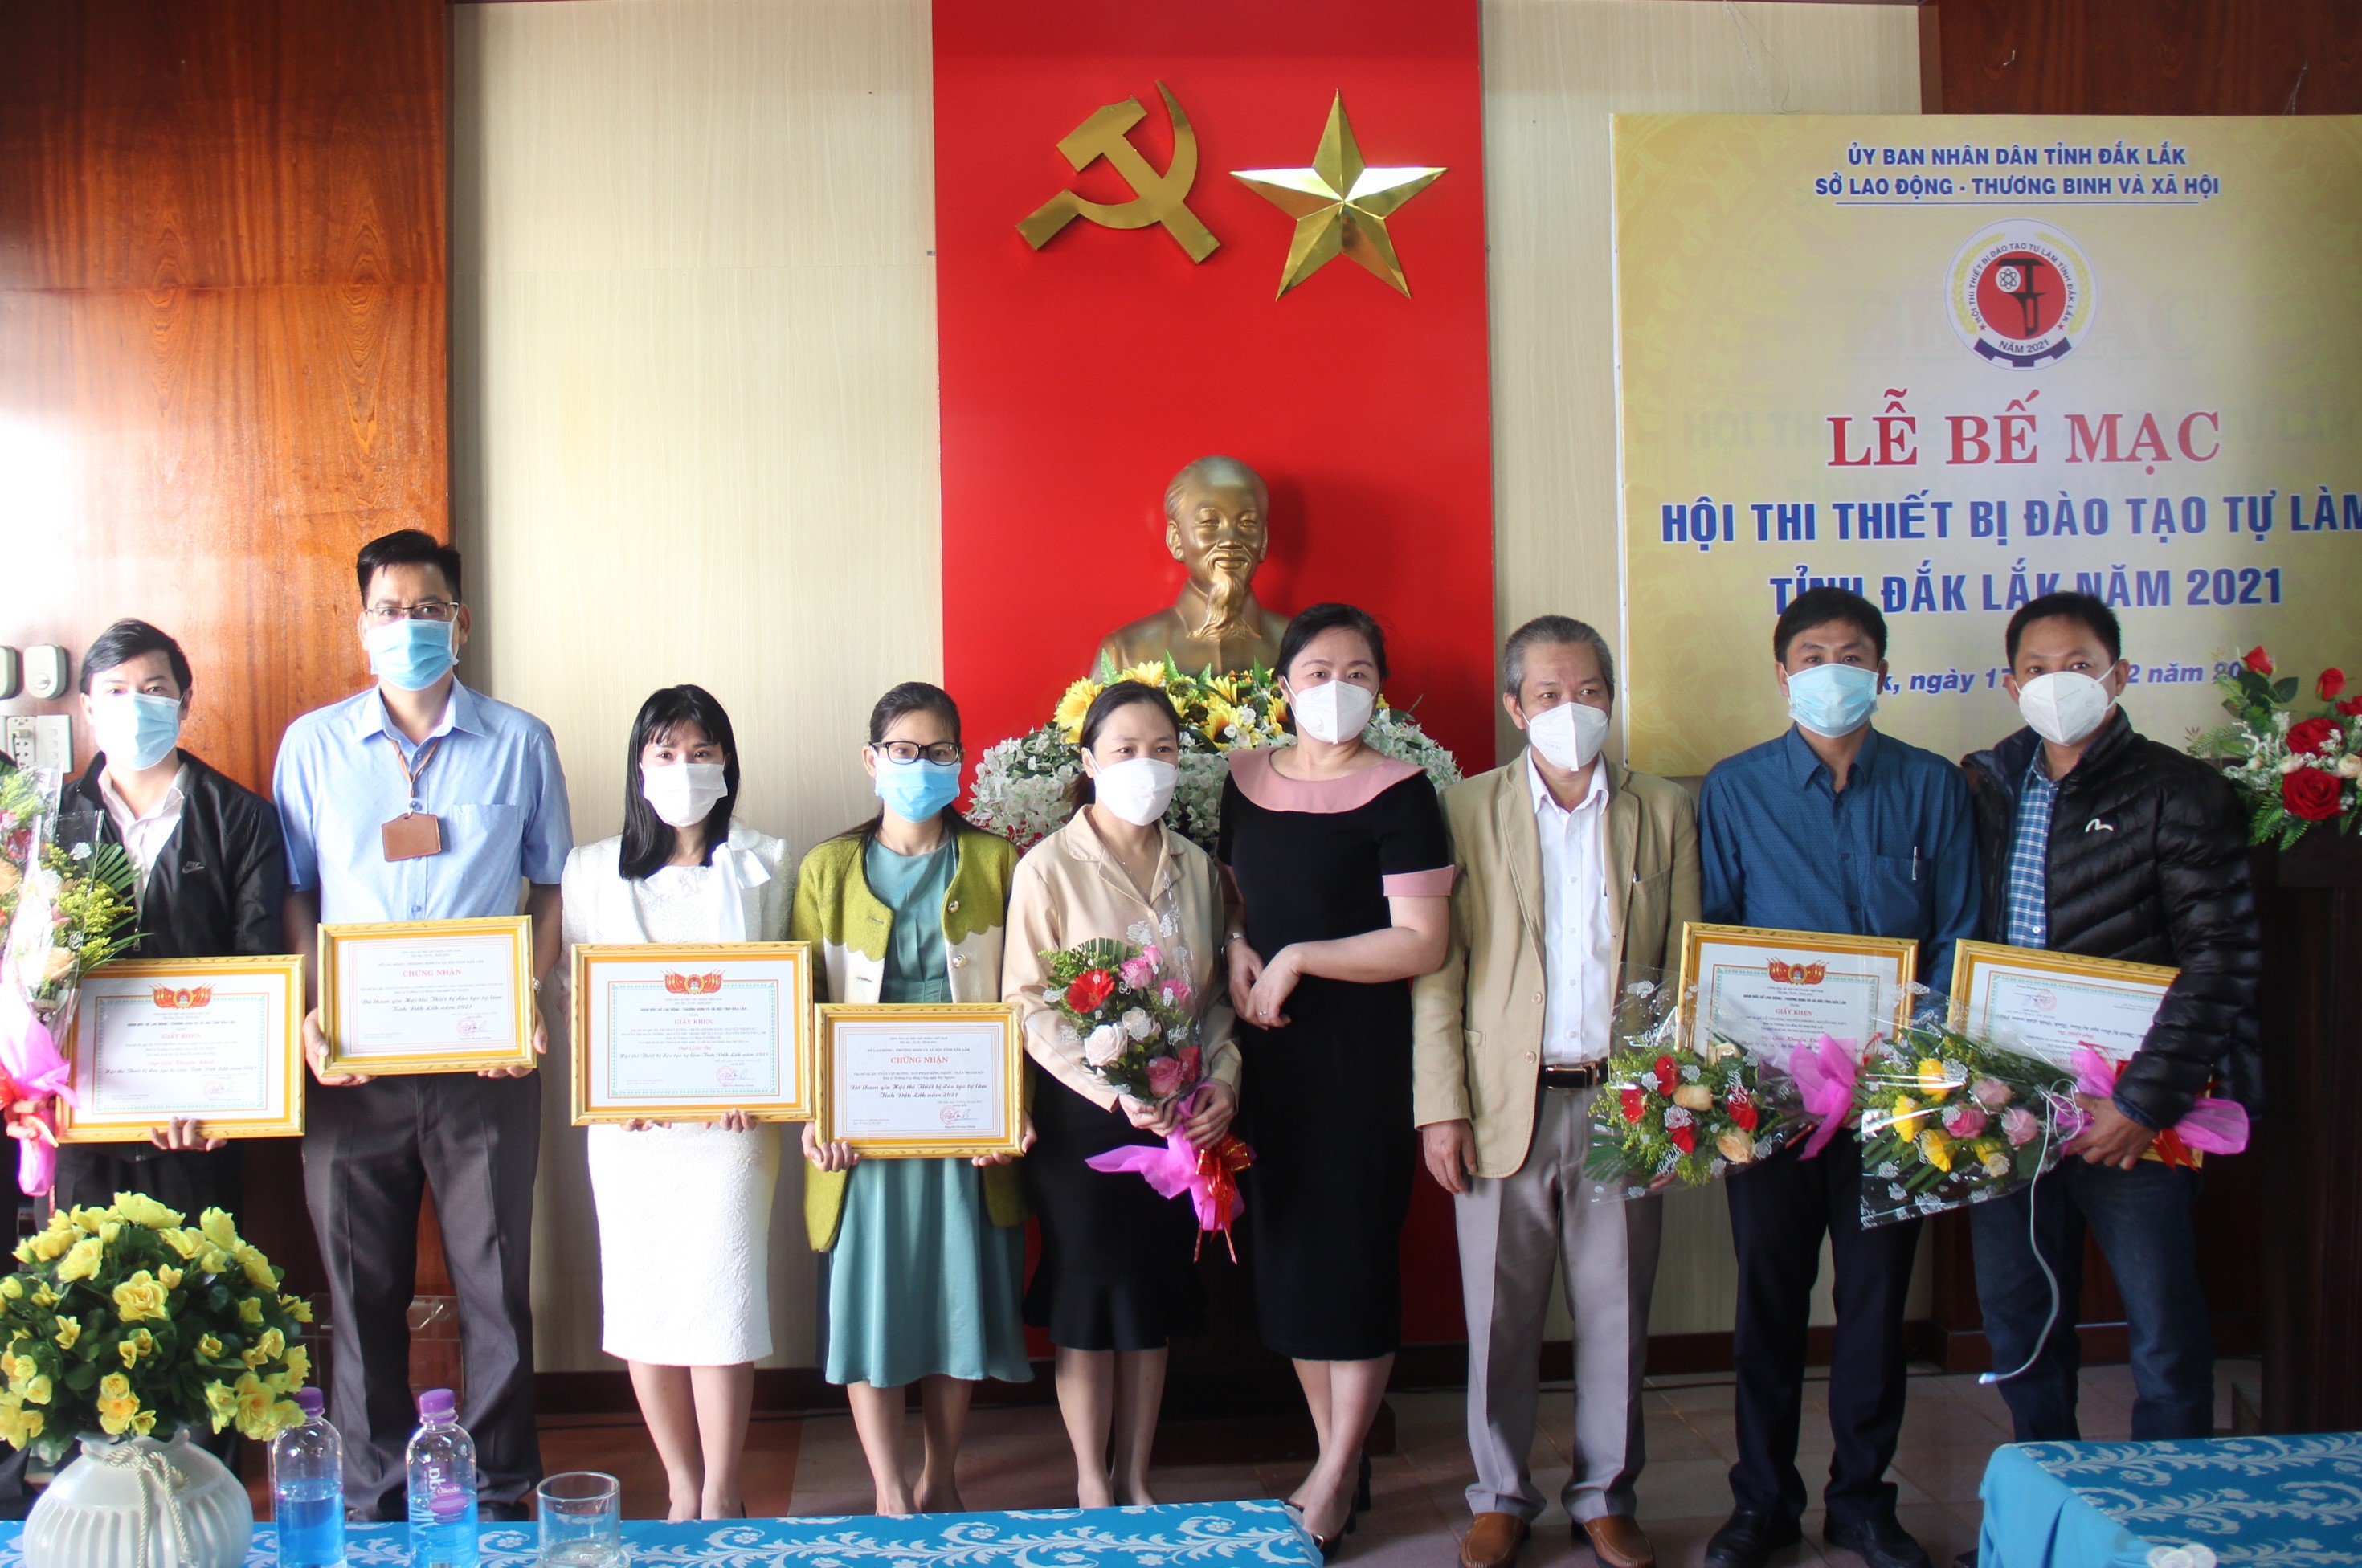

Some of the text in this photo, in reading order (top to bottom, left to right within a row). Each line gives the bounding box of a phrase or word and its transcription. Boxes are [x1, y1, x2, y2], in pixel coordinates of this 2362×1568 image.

[1848, 141, 2186, 165] ỦY BAN NHÂN DÂN TỈNH ĐẮK LẮK
[1815, 171, 1843, 195] SỞ
[1849, 178, 1890, 195] LAO
[1895, 174, 1953, 200] ĐỘNG
[1972, 174, 2056, 195] THƯƠNG
[2062, 178, 2111, 194] BINH
[2118, 174, 2145, 194] VÀ
[2151, 174, 2178, 194] XÃ
[2184, 174, 2218, 199] HỘI
[1990, 245, 2008, 257] ĐÀO
[2029, 243, 2041, 252] TỰ
[2041, 248, 2058, 263] LÀM
[1981, 255, 1991, 265] BỊ
[1969, 265, 1983, 289] THIẾT
[2058, 260, 2071, 284] TỈNH
[2066, 284, 2076, 302] ĐẮK
[1971, 308, 1982, 324] HỘI
[2062, 304, 2074, 322] LẮK
[1999, 339, 2049, 353] NĂM 2021
[1826, 388, 1918, 466] LỄ
[1945, 389, 2040, 465] BẾ
[2065, 411, 2220, 475] MẠC
[1661, 496, 1734, 552] HỘI
[1750, 503, 1816, 541] THI
[1832, 489, 1953, 540] THIẾT
[1970, 500, 2008, 546] BỊ
[2024, 491, 2109, 536] ĐÀO
[2125, 496, 2206, 543] TẠO
[2223, 490, 2276, 541] TỰ
[1770, 566, 1863, 615] TỈ
[1880, 560, 1966, 613] ĐẮK
[2186, 567, 2281, 606] 2021
[1910, 668, 1975, 694] ngày
[2147, 662, 2203, 683] năm
[891, 1056, 949, 1064] CHỨNG NHẬN
